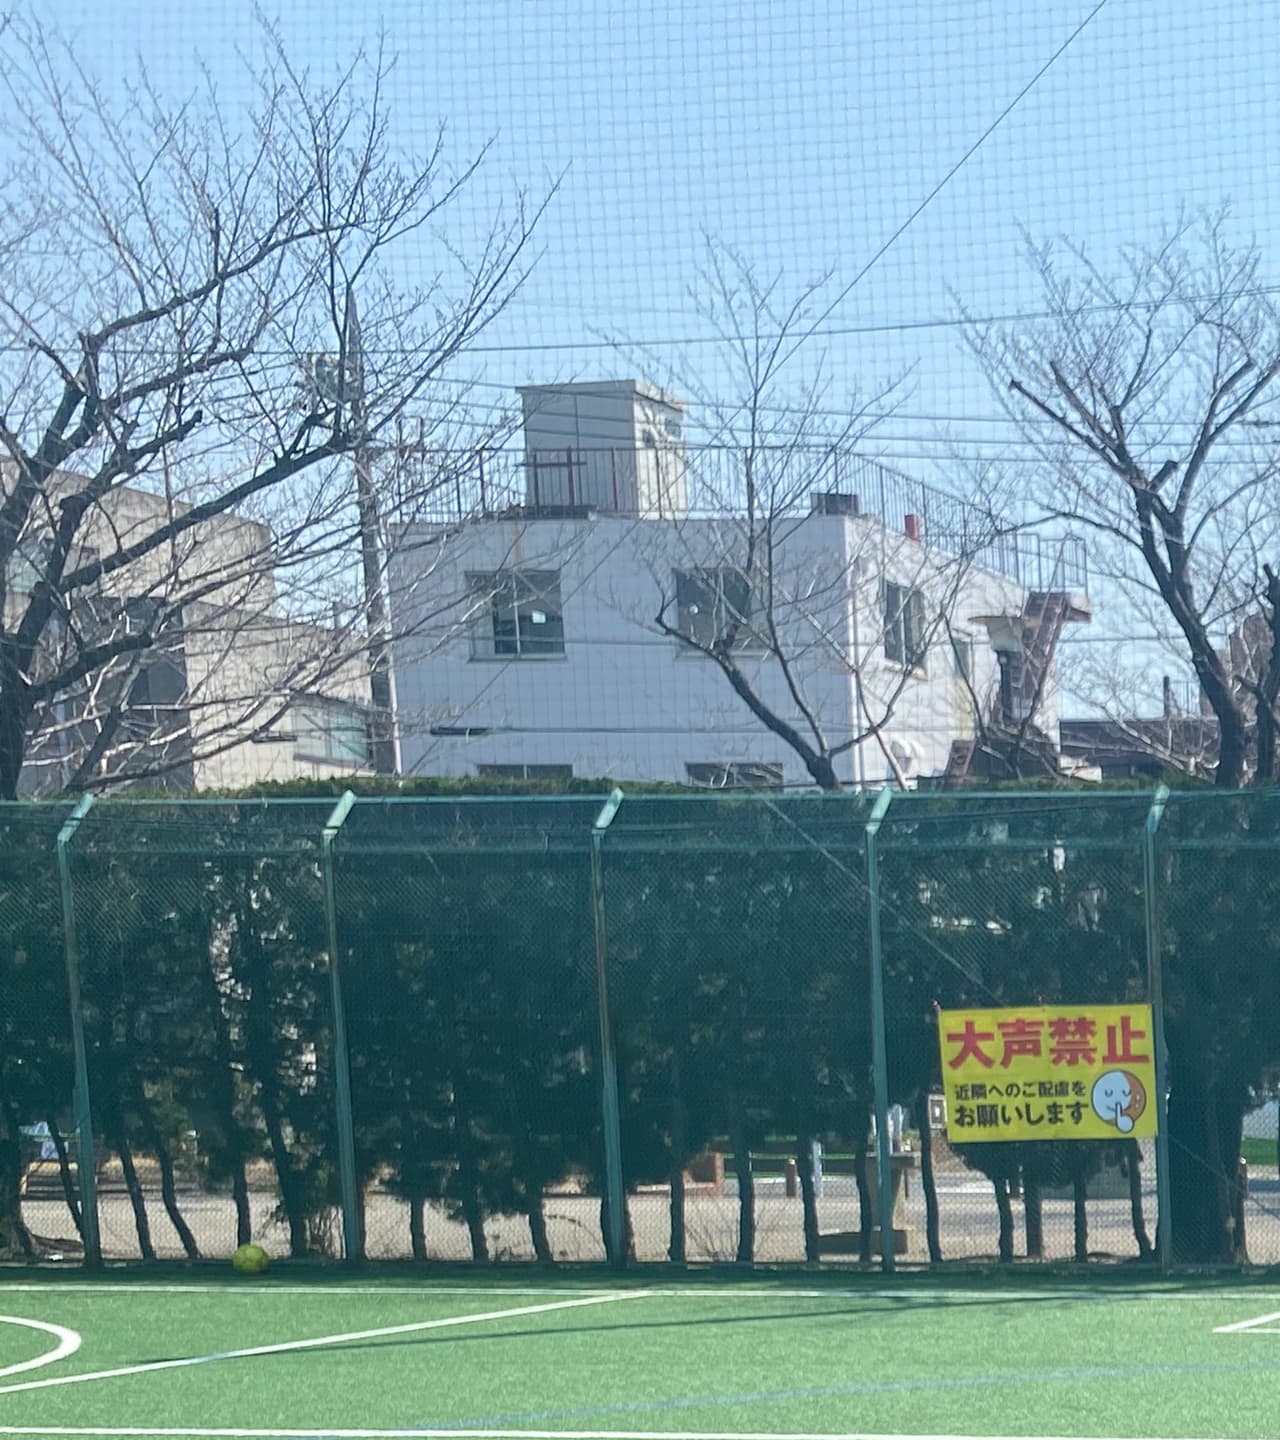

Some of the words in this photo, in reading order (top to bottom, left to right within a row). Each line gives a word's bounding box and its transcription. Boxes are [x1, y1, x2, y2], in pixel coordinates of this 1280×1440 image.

[947, 1015, 1150, 1070] 大声禁止
[954, 1080, 1087, 1100] 近隣へのご配慮を
[954, 1101, 1089, 1128] お願いします
